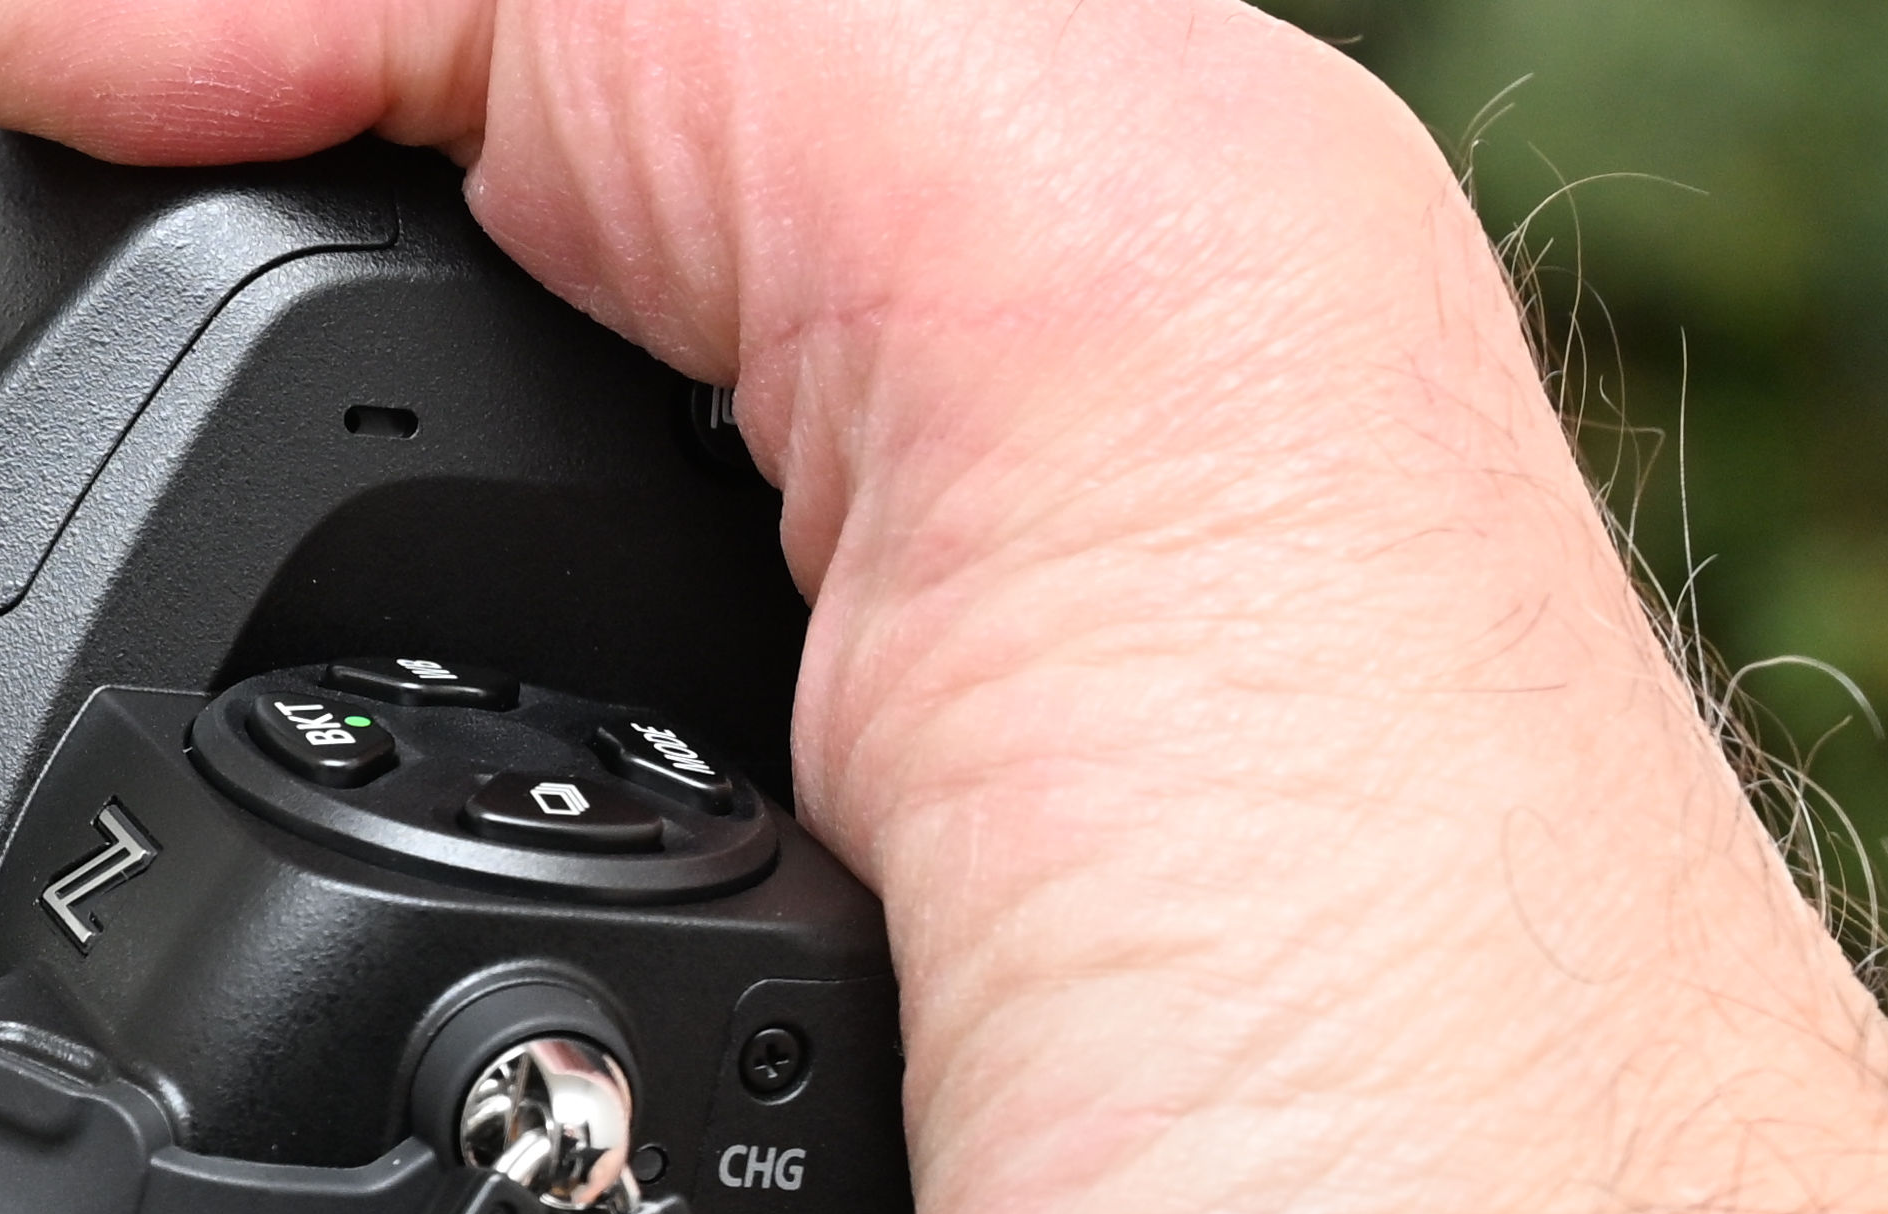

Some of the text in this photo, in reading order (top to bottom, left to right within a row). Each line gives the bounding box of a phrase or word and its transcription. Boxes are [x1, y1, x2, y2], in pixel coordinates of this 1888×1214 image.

[396, 658, 459, 679] WB
[274, 701, 356, 746] BKT
[630, 722, 716, 775] MODE
[42, 804, 159, 944] Z
[718, 1144, 806, 1191] CHG
